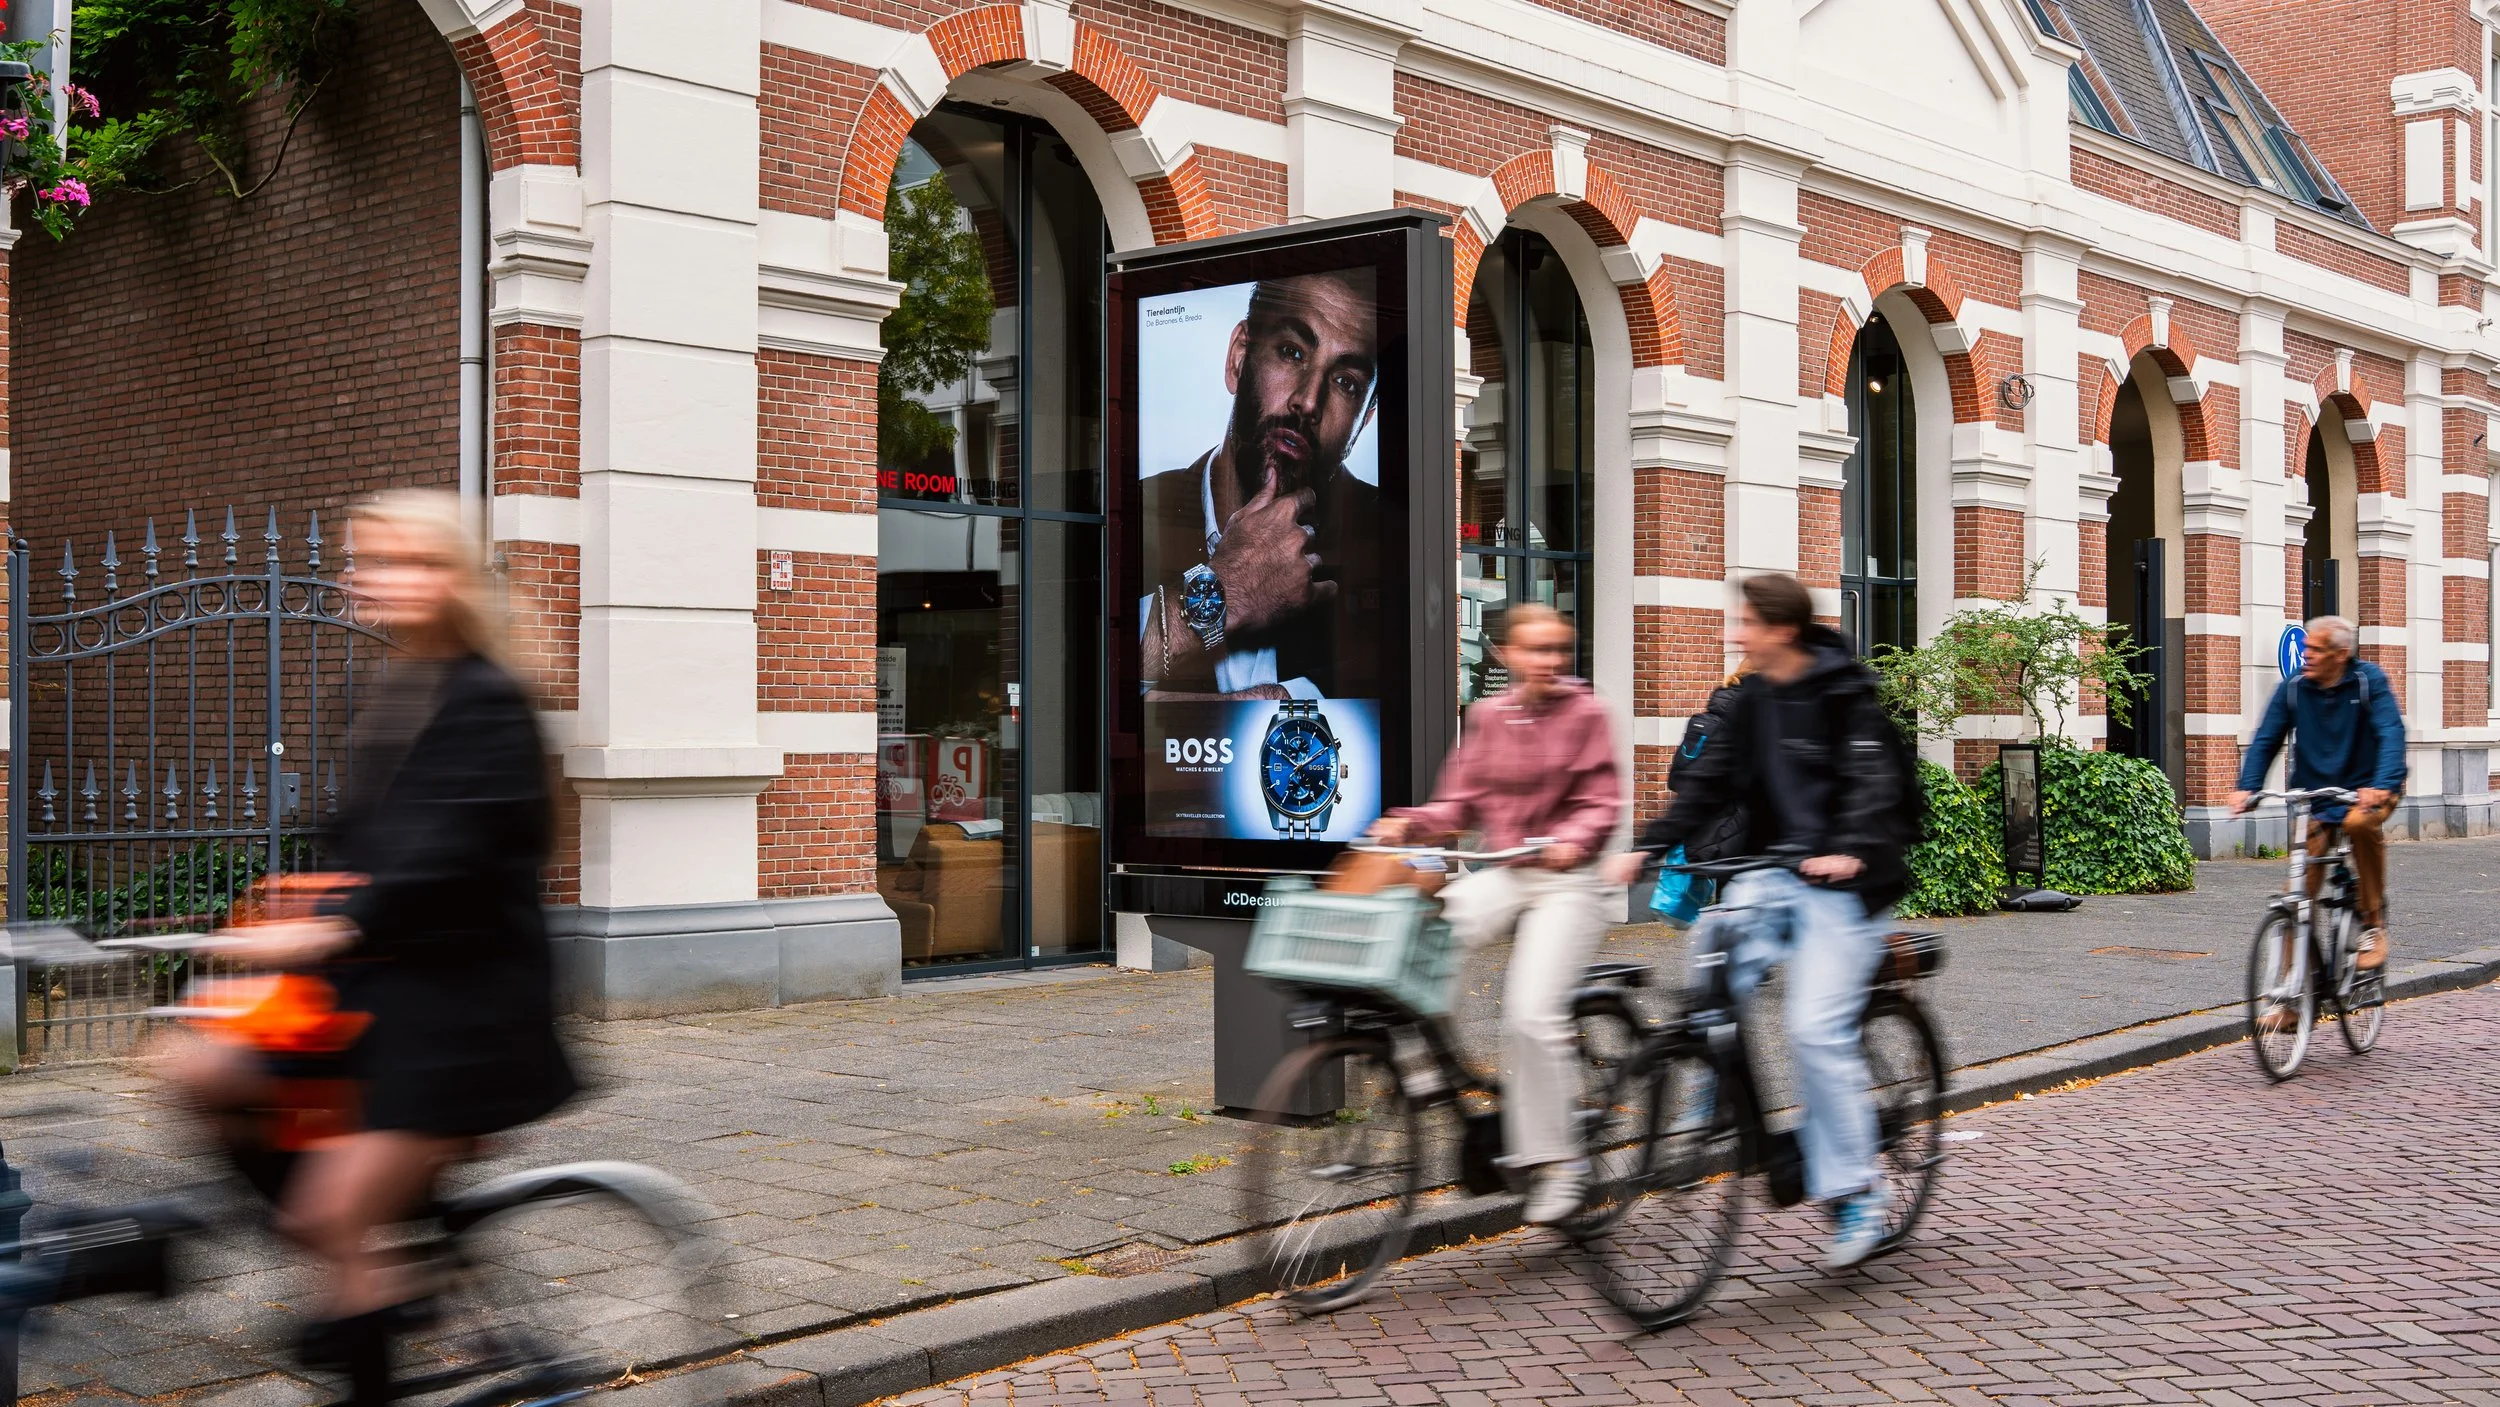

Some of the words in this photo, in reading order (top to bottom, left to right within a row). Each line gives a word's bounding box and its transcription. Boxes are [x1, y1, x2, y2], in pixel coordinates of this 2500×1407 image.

[1146, 305, 1186, 317] Tierelantijn
[1146, 320, 1154, 328] De
[1155, 318, 1178, 327] Barones
[1185, 313, 1202, 322] Breda
[905, 472, 956, 494] ROOM
[1461, 523, 1479, 538] OM
[1165, 737, 1234, 764] BOSS
